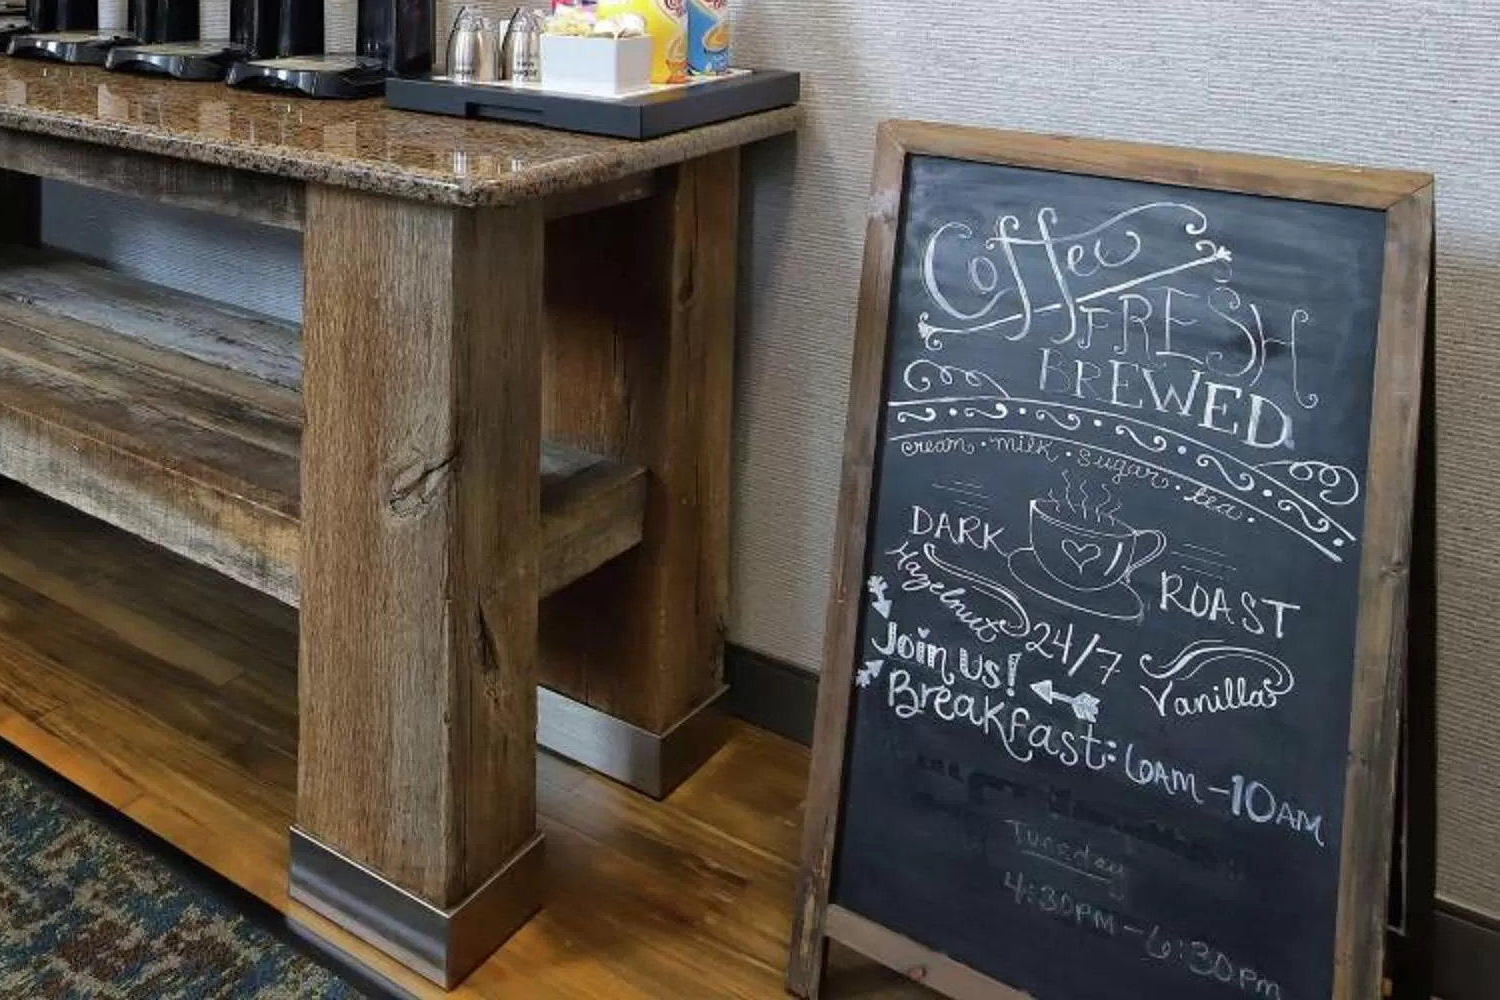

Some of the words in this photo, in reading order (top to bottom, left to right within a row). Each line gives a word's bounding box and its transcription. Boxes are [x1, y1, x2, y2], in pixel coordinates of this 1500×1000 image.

[923, 202, 1144, 345] Coffee
[1078, 286, 1318, 409] FRESH
[1040, 347, 1294, 450] BREWED
[900, 435, 976, 458] cream
[988, 433, 1060, 463] milk
[1184, 486, 1244, 521] tea
[909, 504, 1008, 558] DARK
[885, 541, 1003, 643] Hazelnut
[1159, 569, 1301, 640] ROAST
[871, 620, 956, 686] Join
[1025, 620, 1123, 686] 24/7
[1140, 675, 1285, 718] Vanilla
[887, 670, 1117, 770] Breakfast:
